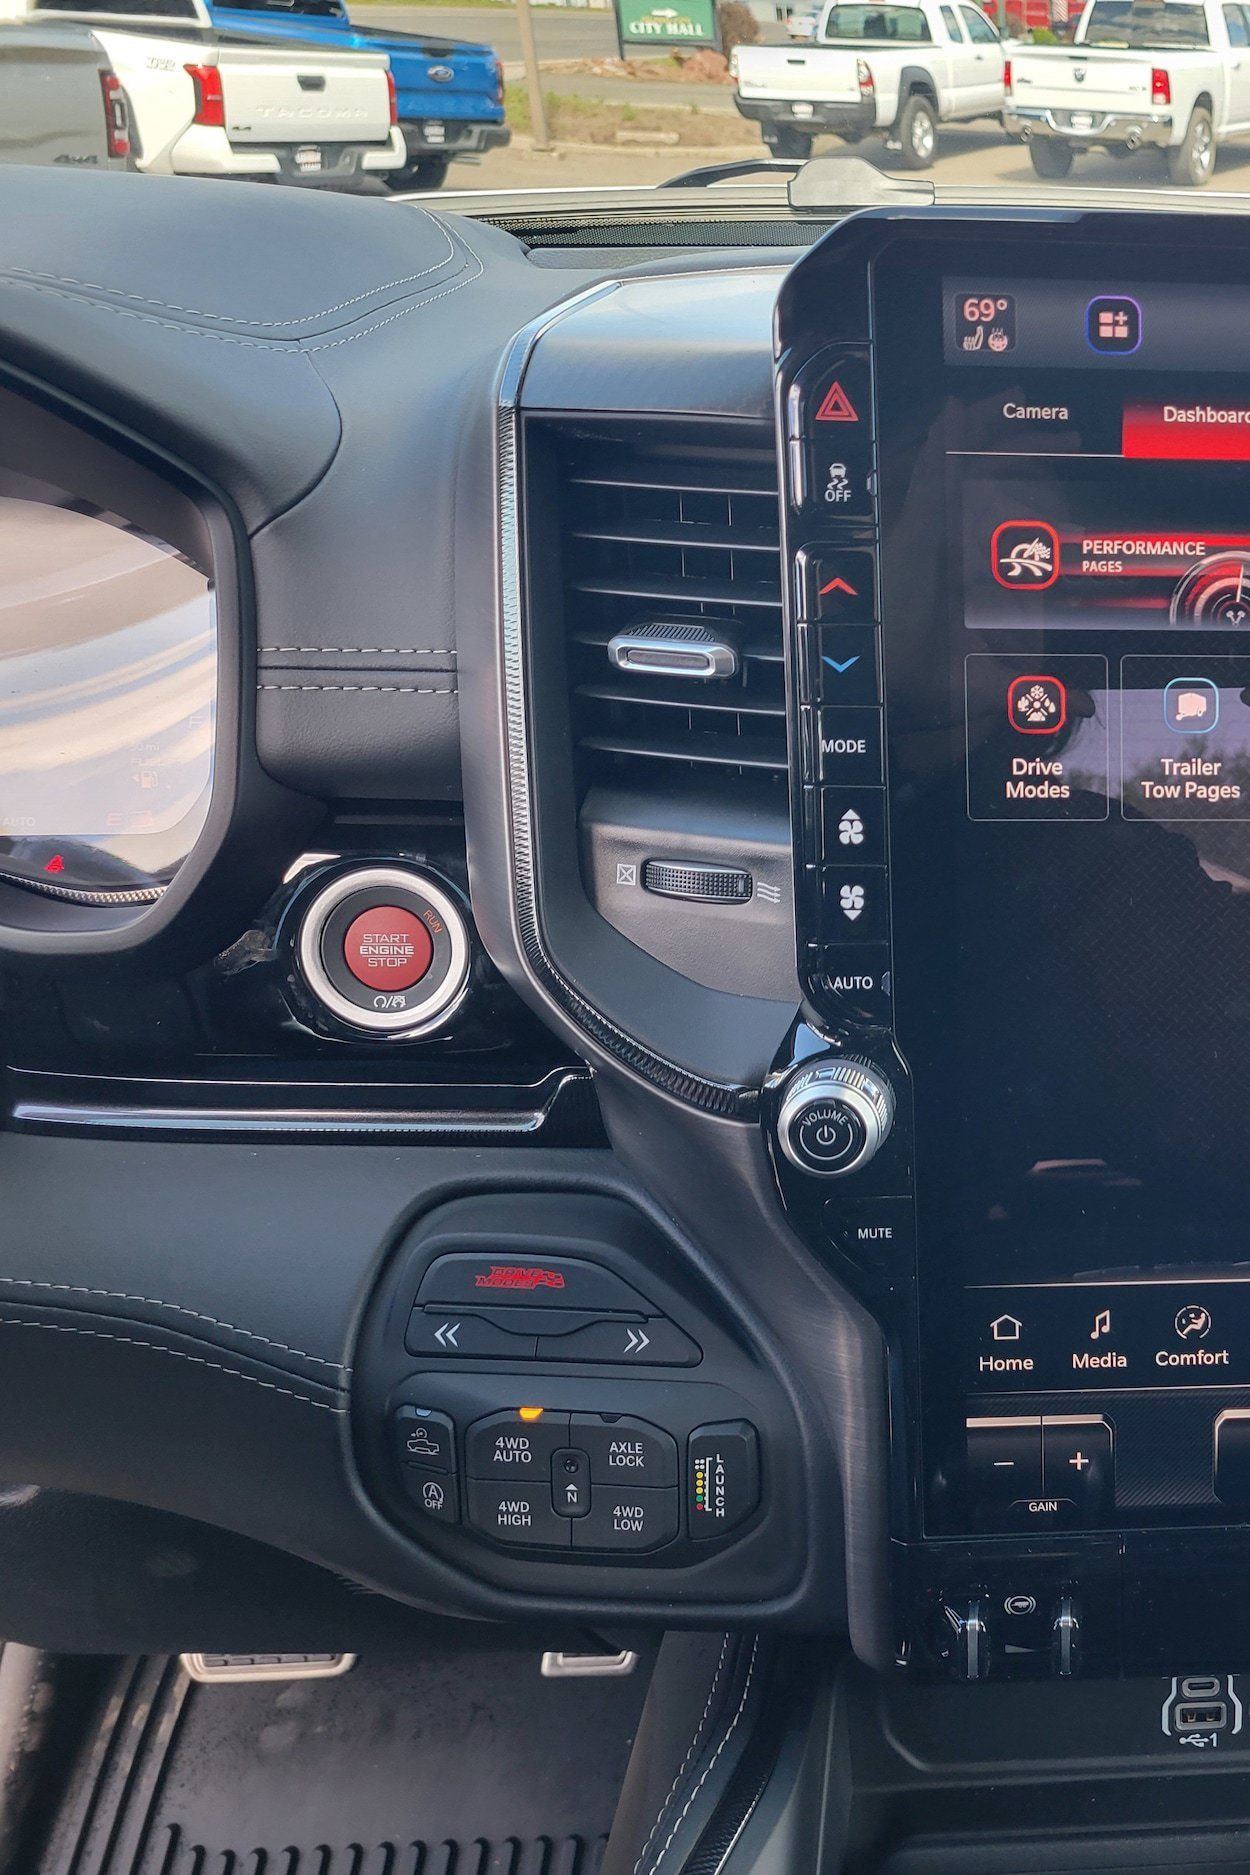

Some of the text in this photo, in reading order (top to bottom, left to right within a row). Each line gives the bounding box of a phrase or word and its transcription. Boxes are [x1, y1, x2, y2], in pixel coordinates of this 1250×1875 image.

[628, 21, 704, 36] CITY HALL
[256, 105, 368, 119] TACOMA
[963, 298, 1008, 321] 69°
[1002, 403, 1069, 421] Camera
[824, 490, 851, 502] OFF
[1082, 540, 1206, 556] PERFORMANCE
[1082, 561, 1123, 573] PAGES
[821, 739, 867, 753] MODE
[1012, 758, 1063, 776] Drive
[1161, 758, 1221, 776] Trailer
[1006, 781, 1070, 799] Modes
[1142, 782, 1240, 802] Tow Pages
[423, 909, 443, 934] RUN
[363, 933, 409, 943] START
[359, 945, 414, 955] ENGINE
[368, 957, 407, 967] STOP
[833, 976, 873, 989] AUTO
[802, 1109, 849, 1127] VOLUME
[857, 1227, 893, 1239] MUTE
[979, 1356, 1034, 1371] Home
[1072, 1352, 1127, 1369] Media
[1155, 1350, 1229, 1366] Comfort
[495, 1437, 530, 1450] 4WD
[609, 1442, 643, 1454] AXLE
[493, 1450, 532, 1463] AUTO
[608, 1454, 645, 1467] LOCK
[715, 1453, 725, 1517] LAUNCH
[567, 1491, 577, 1503] N
[424, 1498, 443, 1510] OFF
[498, 1501, 530, 1514] 4WD
[1028, 1502, 1057, 1512] GAIN
[613, 1506, 644, 1518] 4WD
[497, 1514, 532, 1527] HIGH
[613, 1518, 644, 1531] LOW
[1209, 1733, 1218, 1747] 1
